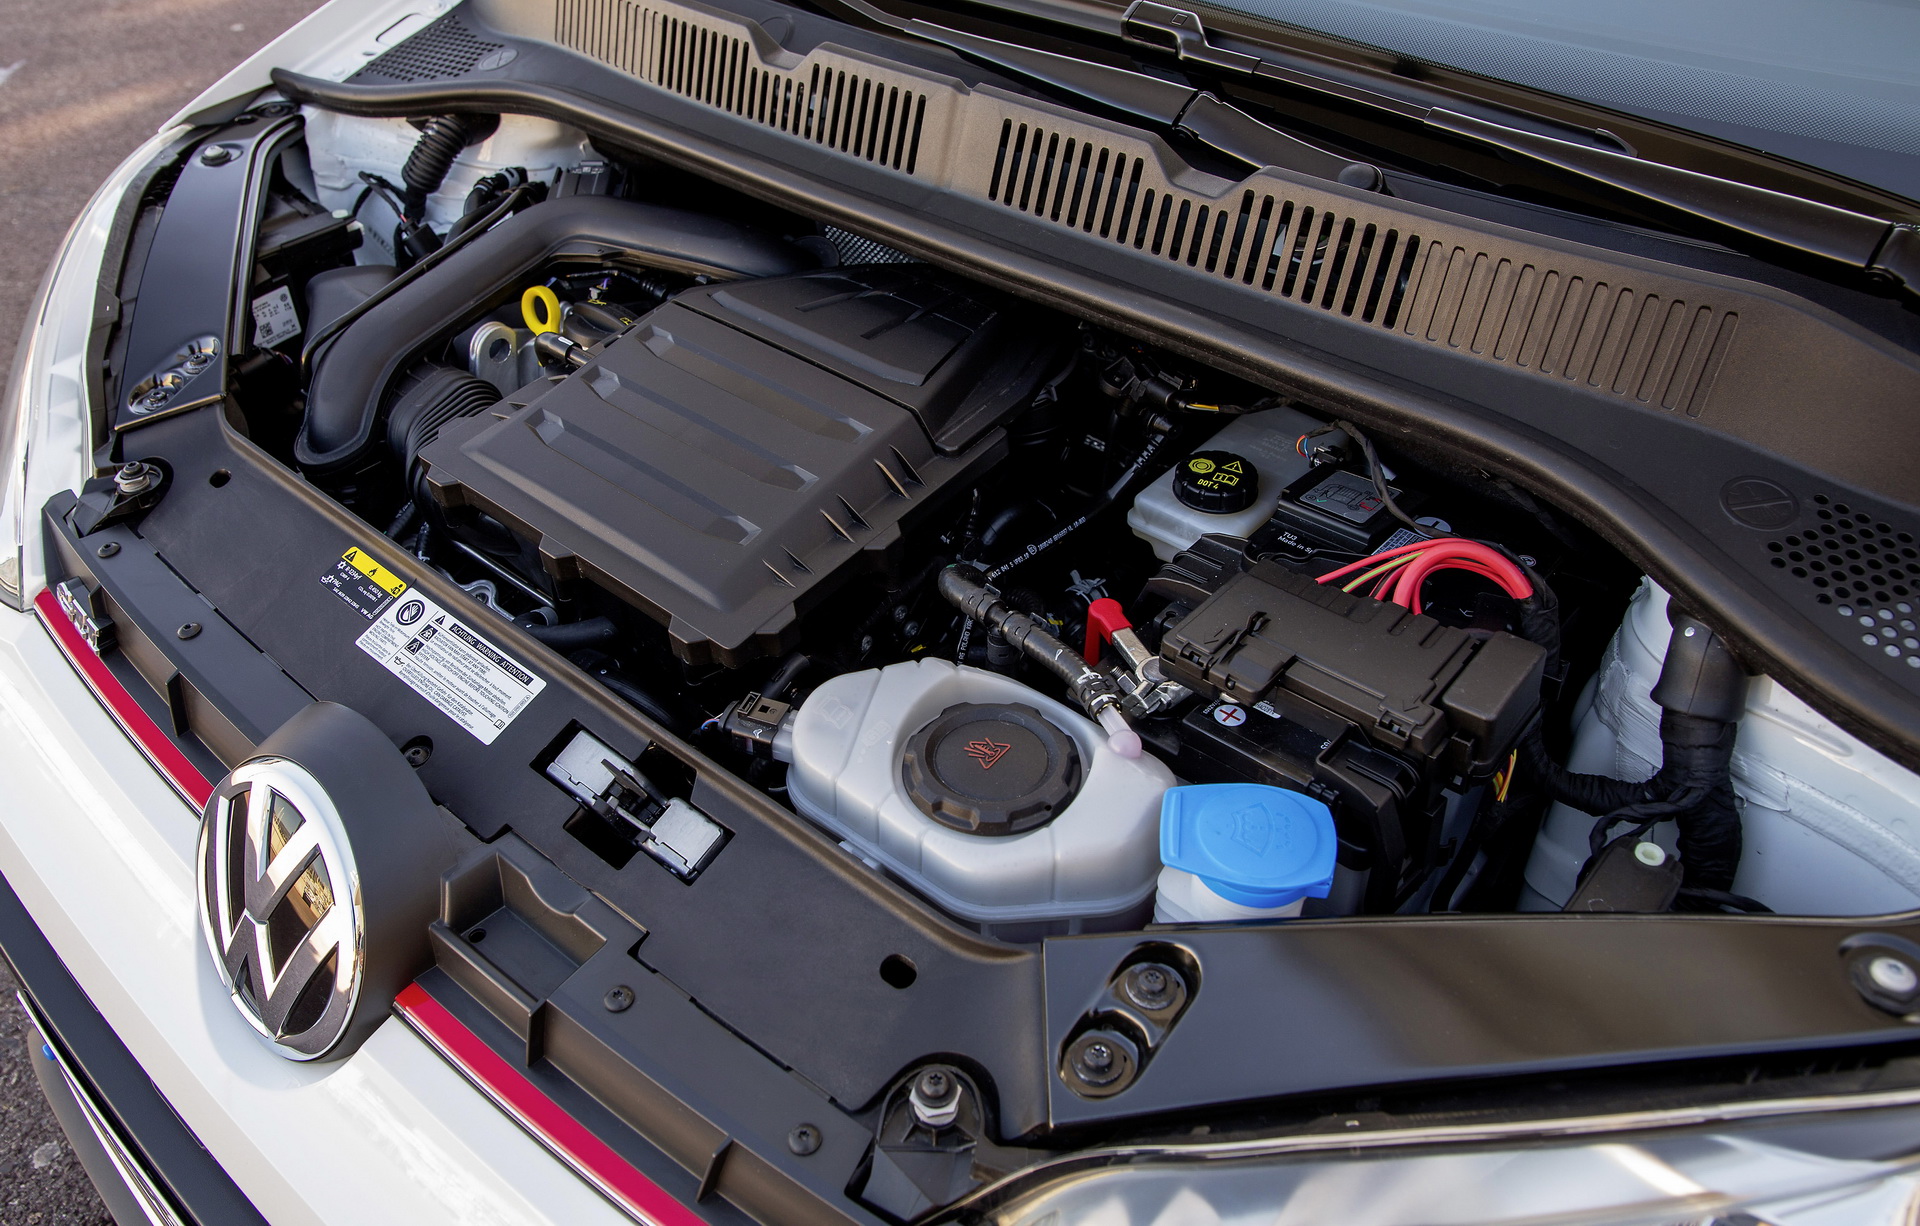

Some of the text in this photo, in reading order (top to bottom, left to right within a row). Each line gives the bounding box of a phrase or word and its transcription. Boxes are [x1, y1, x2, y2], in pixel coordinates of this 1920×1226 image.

[1197, 478, 1214, 488] DOT
[1277, 535, 1297, 547] Made
[1283, 531, 1298, 541] TU3
[331, 578, 343, 588] PAG
[360, 608, 369, 616] VW
[433, 641, 449, 654] ventilateur
[451, 655, 466, 666] radiateur
[451, 625, 530, 683] ACHTUNG WARNING ATTENTION
[459, 654, 470, 662] START
[414, 655, 424, 664] Haute
[445, 678, 457, 688] moteur
[456, 686, 466, 694] avant
[467, 695, 480, 706] toucher
[421, 648, 431, 656] HIGH
[441, 663, 453, 672] SWITCH
[457, 674, 470, 685] ENGINE
[468, 682, 480, 693] BEFORE
[479, 690, 496, 704] TOUCHING
[494, 702, 510, 714] IGNITION
[426, 678, 439, 689] besteht
[418, 679, 430, 688] ENGINE
[433, 690, 441, 698] CAN
[439, 695, 454, 707] DAMAGE
[483, 687, 494, 696] Motor
[448, 709, 457, 717] pour
